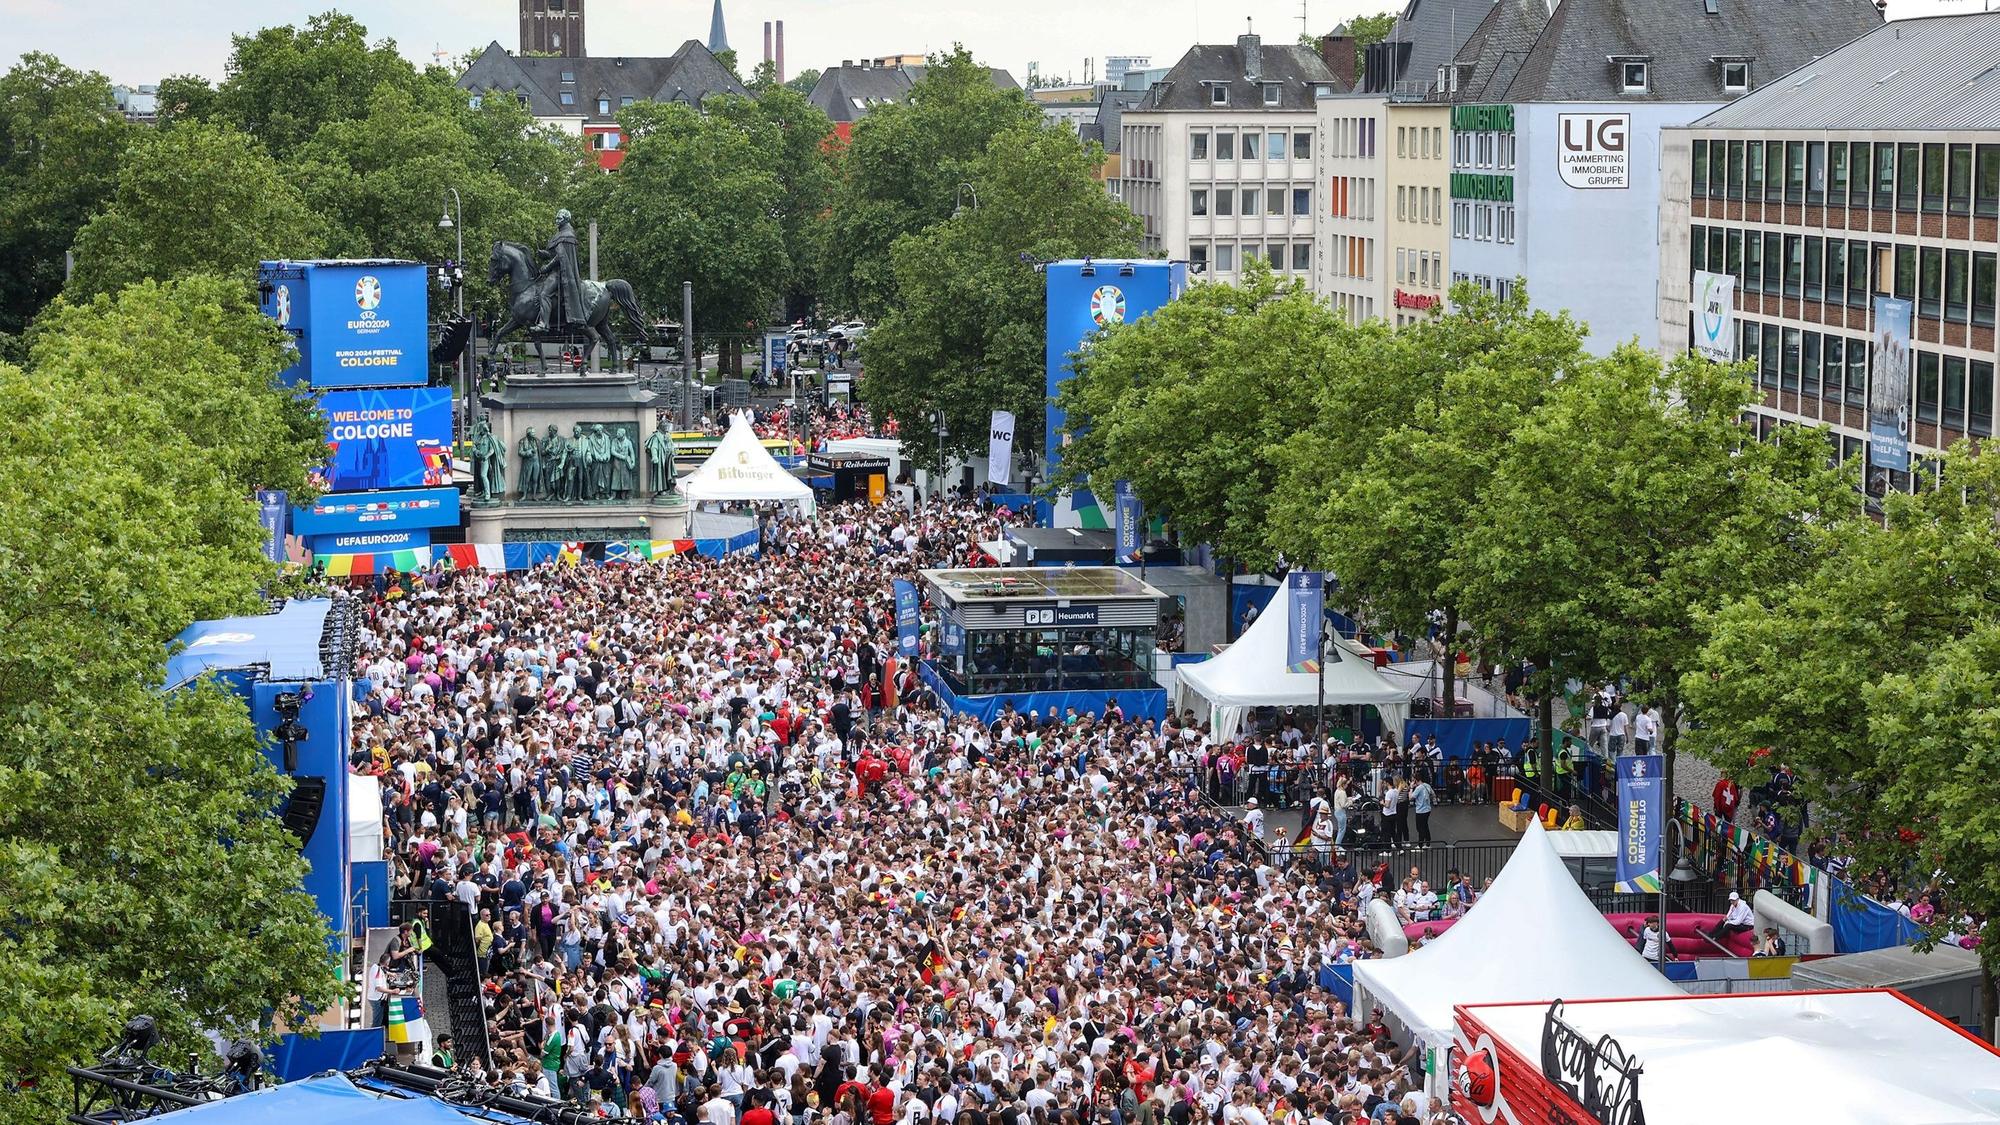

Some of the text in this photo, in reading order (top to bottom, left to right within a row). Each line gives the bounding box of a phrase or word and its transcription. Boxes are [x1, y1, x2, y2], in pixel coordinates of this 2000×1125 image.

[1450, 104, 1514, 131] LAMMERTING
[1564, 119, 1624, 151] LIG
[1563, 155, 1624, 163] LAMMERTING
[1571, 165, 1624, 174] IMMOBILIEN
[1587, 176, 1624, 185] GRUPPE
[1450, 173, 1513, 202] IMMOBILIEN
[347, 320, 390, 329] EURO2024
[340, 356, 397, 367] COLOGNE
[332, 408, 413, 422] WELCOME TO
[332, 423, 413, 441] COLOGNE
[992, 429, 1011, 441] WC
[843, 460, 889, 468] Reibekuchen
[718, 466, 773, 480] Bitburger
[336, 533, 409, 546] UEFAEURO2024
[1058, 611, 1095, 620] Heumarkt
[674, 745, 681, 756] 9
